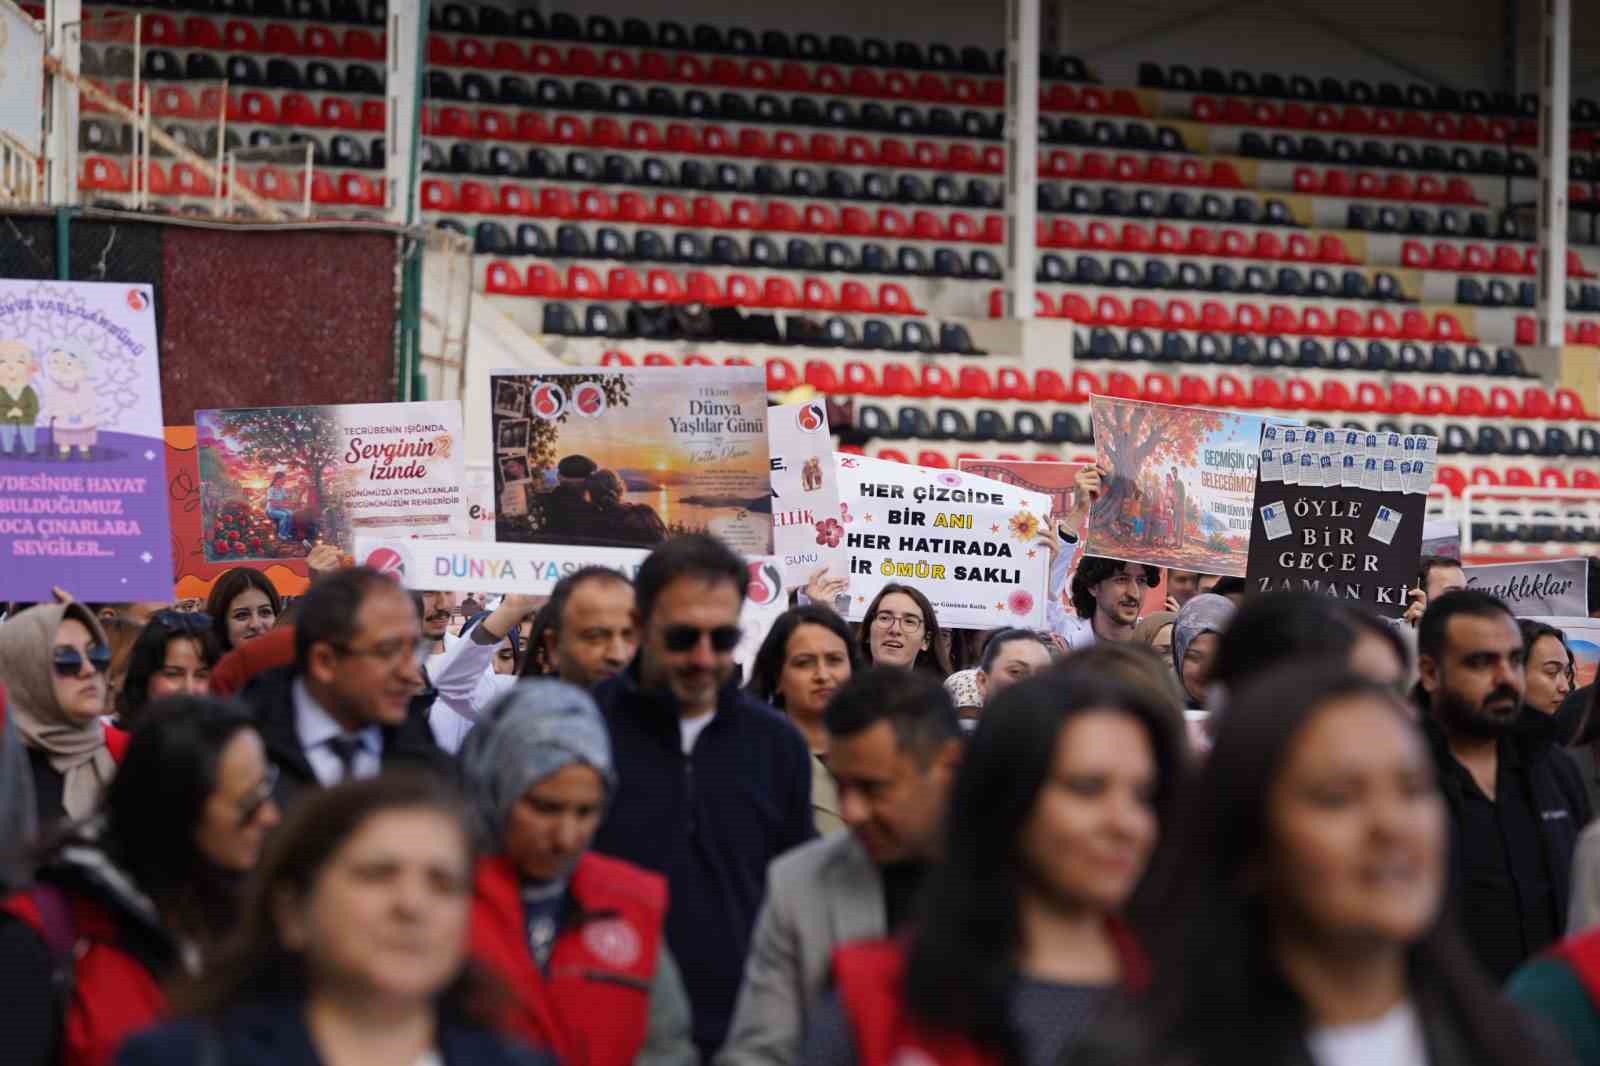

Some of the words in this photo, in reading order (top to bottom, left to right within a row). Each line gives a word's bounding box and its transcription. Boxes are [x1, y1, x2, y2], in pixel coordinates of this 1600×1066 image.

[689, 399, 742, 419] Dünya
[344, 426, 402, 435] TECRÜBENİN
[669, 416, 724, 437] Yaşlılar
[727, 417, 764, 433] Günü
[345, 437, 436, 465] Sevginin
[1204, 448, 1245, 472] GEÇMİŞİN
[87, 477, 147, 493] HAYAT
[860, 483, 905, 499] HER
[913, 484, 1004, 506] ÇİZGİDE
[888, 507, 926, 526] BİR
[934, 512, 974, 529] ANI
[1294, 498, 1363, 519] ÖYLE
[37, 519, 142, 539] ÇINARLARA
[1303, 527, 1355, 547] BİR
[847, 533, 891, 550] HER
[899, 536, 1012, 558] HATIRADA
[435, 554, 516, 580] DÜNYA
[784, 552, 818, 567] GÜNÜ
[1278, 552, 1379, 574] GEÇER
[880, 558, 946, 580] ÖMÜR
[953, 565, 1021, 584] SAKLI
[1258, 577, 1361, 600] ZAMAN
[1376, 584, 1409, 606] Kİ
